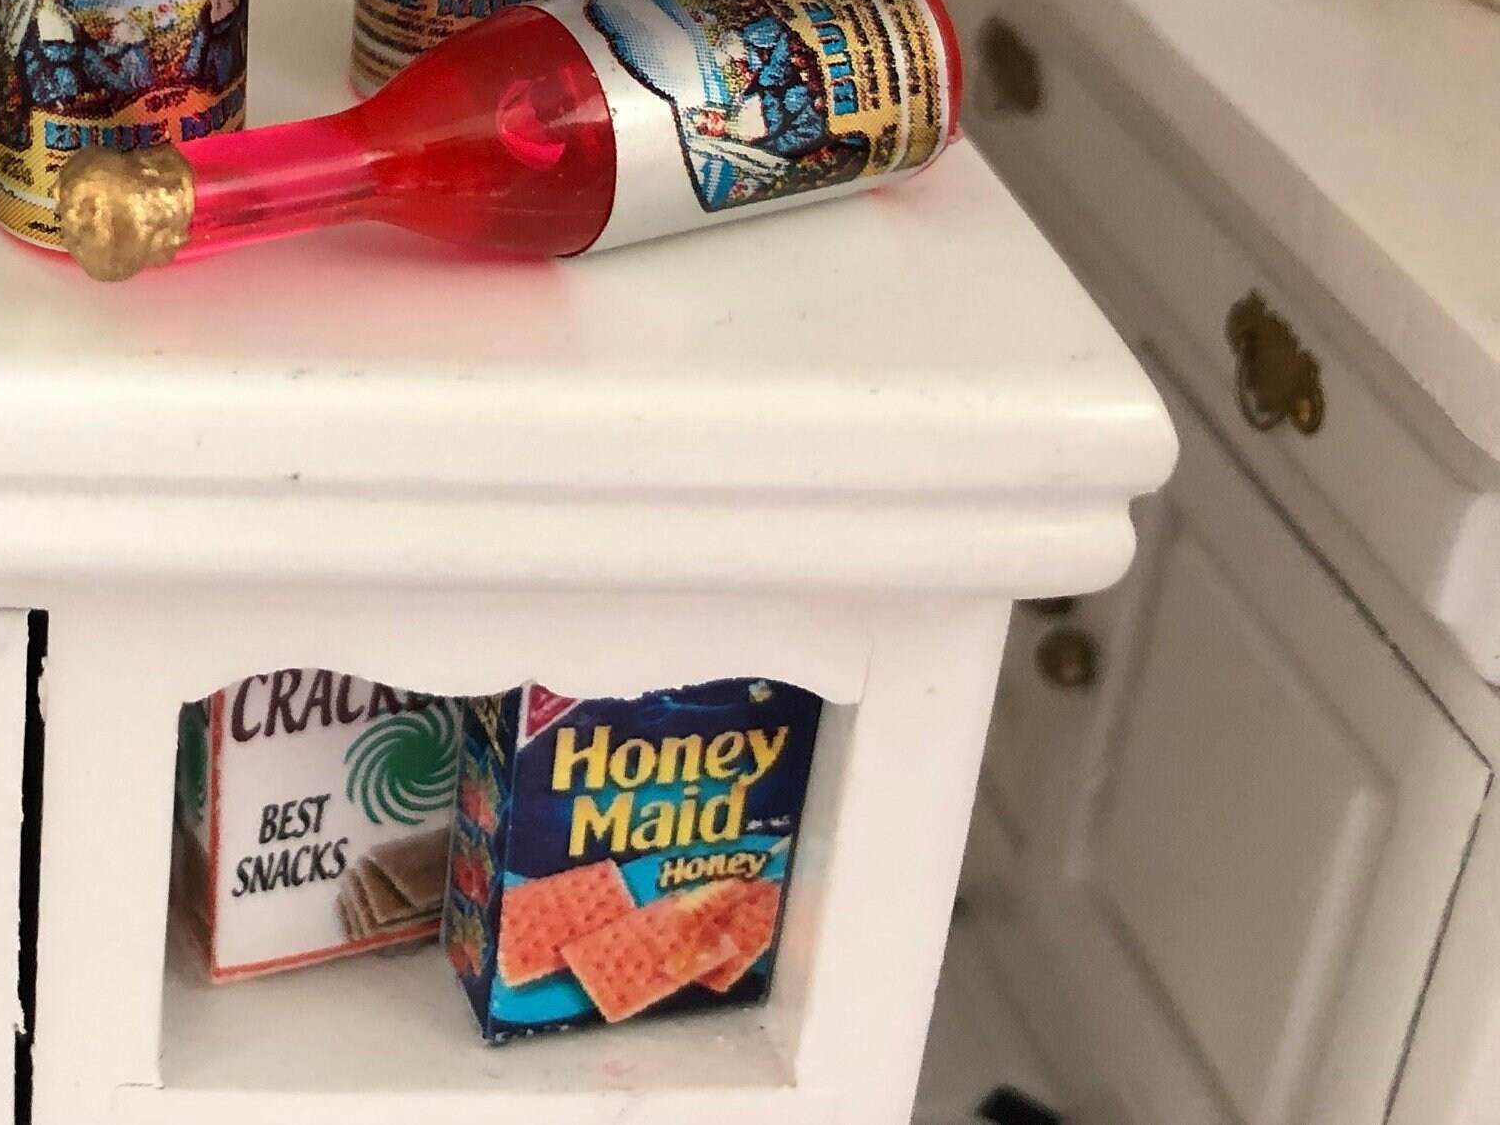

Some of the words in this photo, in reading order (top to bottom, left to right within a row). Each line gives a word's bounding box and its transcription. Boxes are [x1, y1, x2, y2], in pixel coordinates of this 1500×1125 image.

[551, 725, 789, 792] Honey
[258, 793, 331, 844] BEST
[568, 782, 748, 858] Maid
[231, 837, 348, 897] SNACKS
[657, 852, 768, 890] Honey
